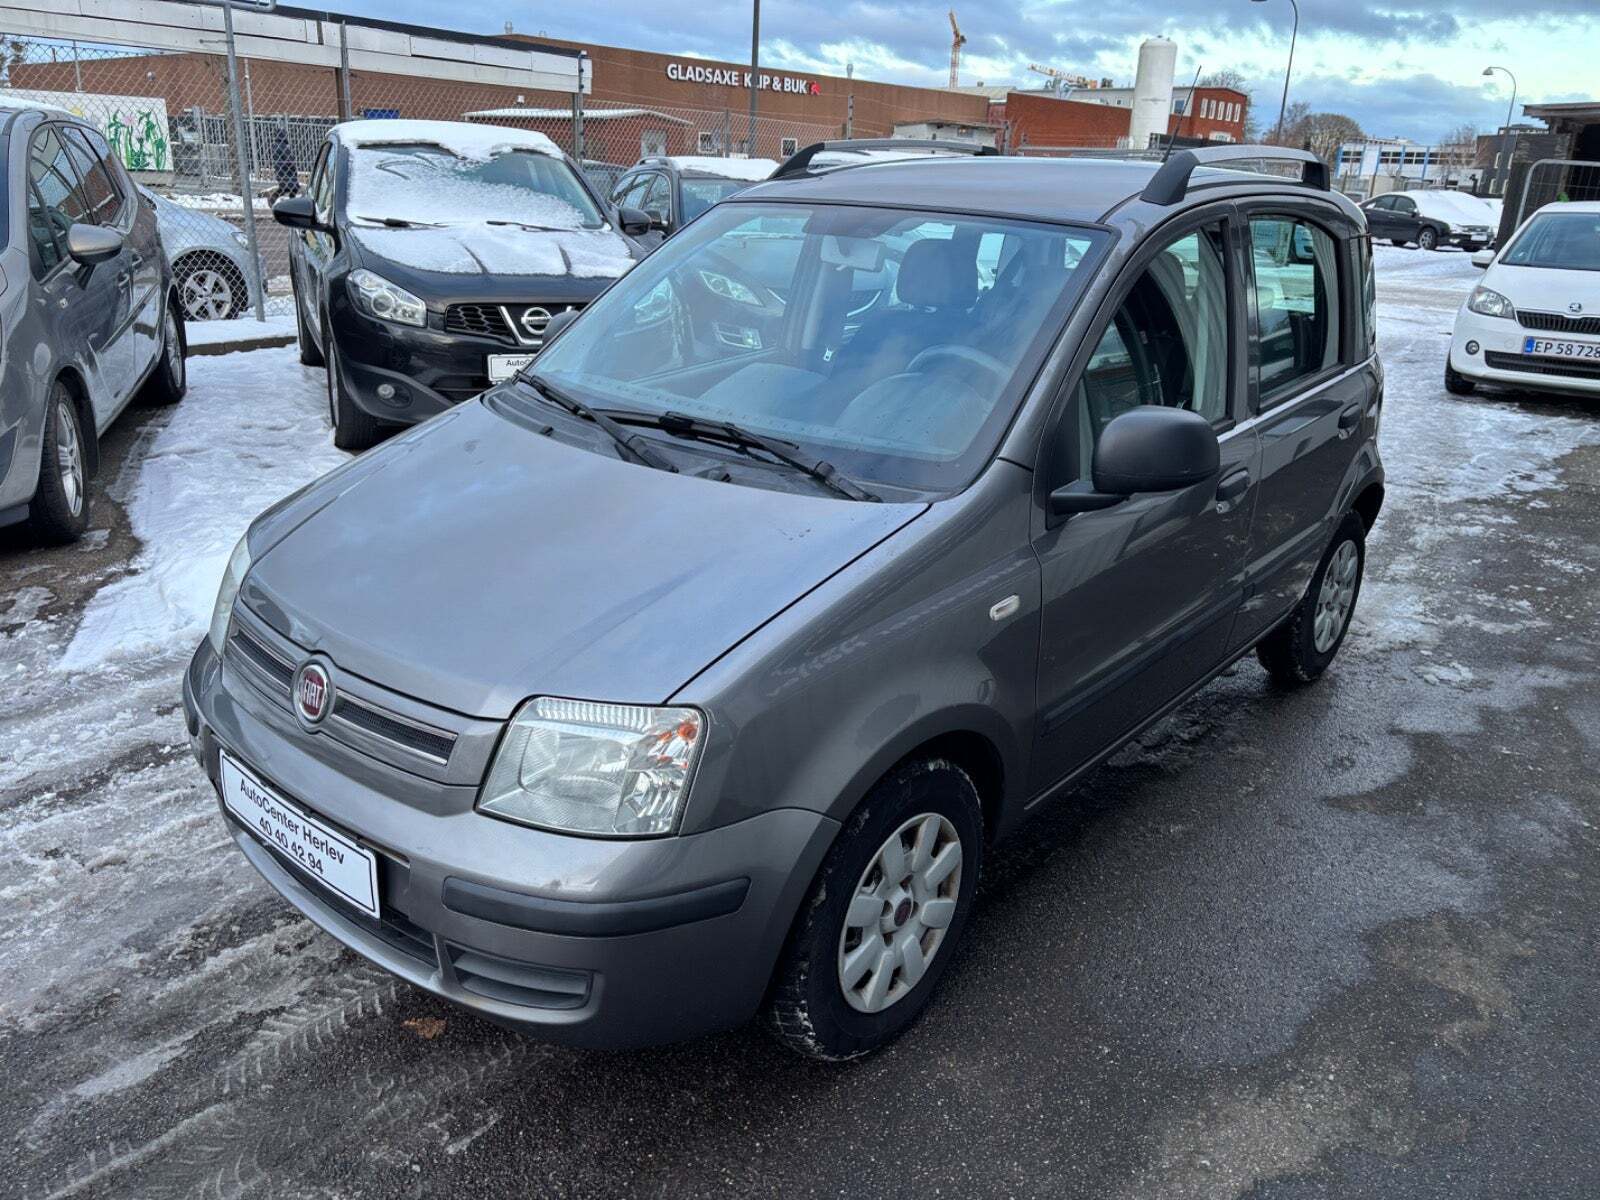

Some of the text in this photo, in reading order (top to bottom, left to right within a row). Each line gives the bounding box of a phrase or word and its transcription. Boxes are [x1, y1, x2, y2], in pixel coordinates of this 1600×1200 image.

[667, 63, 807, 94] GLADSAXE KIP & BUK
[1535, 342, 1600, 358] EP 58 728
[240, 778, 345, 865] AutoCenter Herlev
[259, 817, 324, 874] 40 40 42 94
